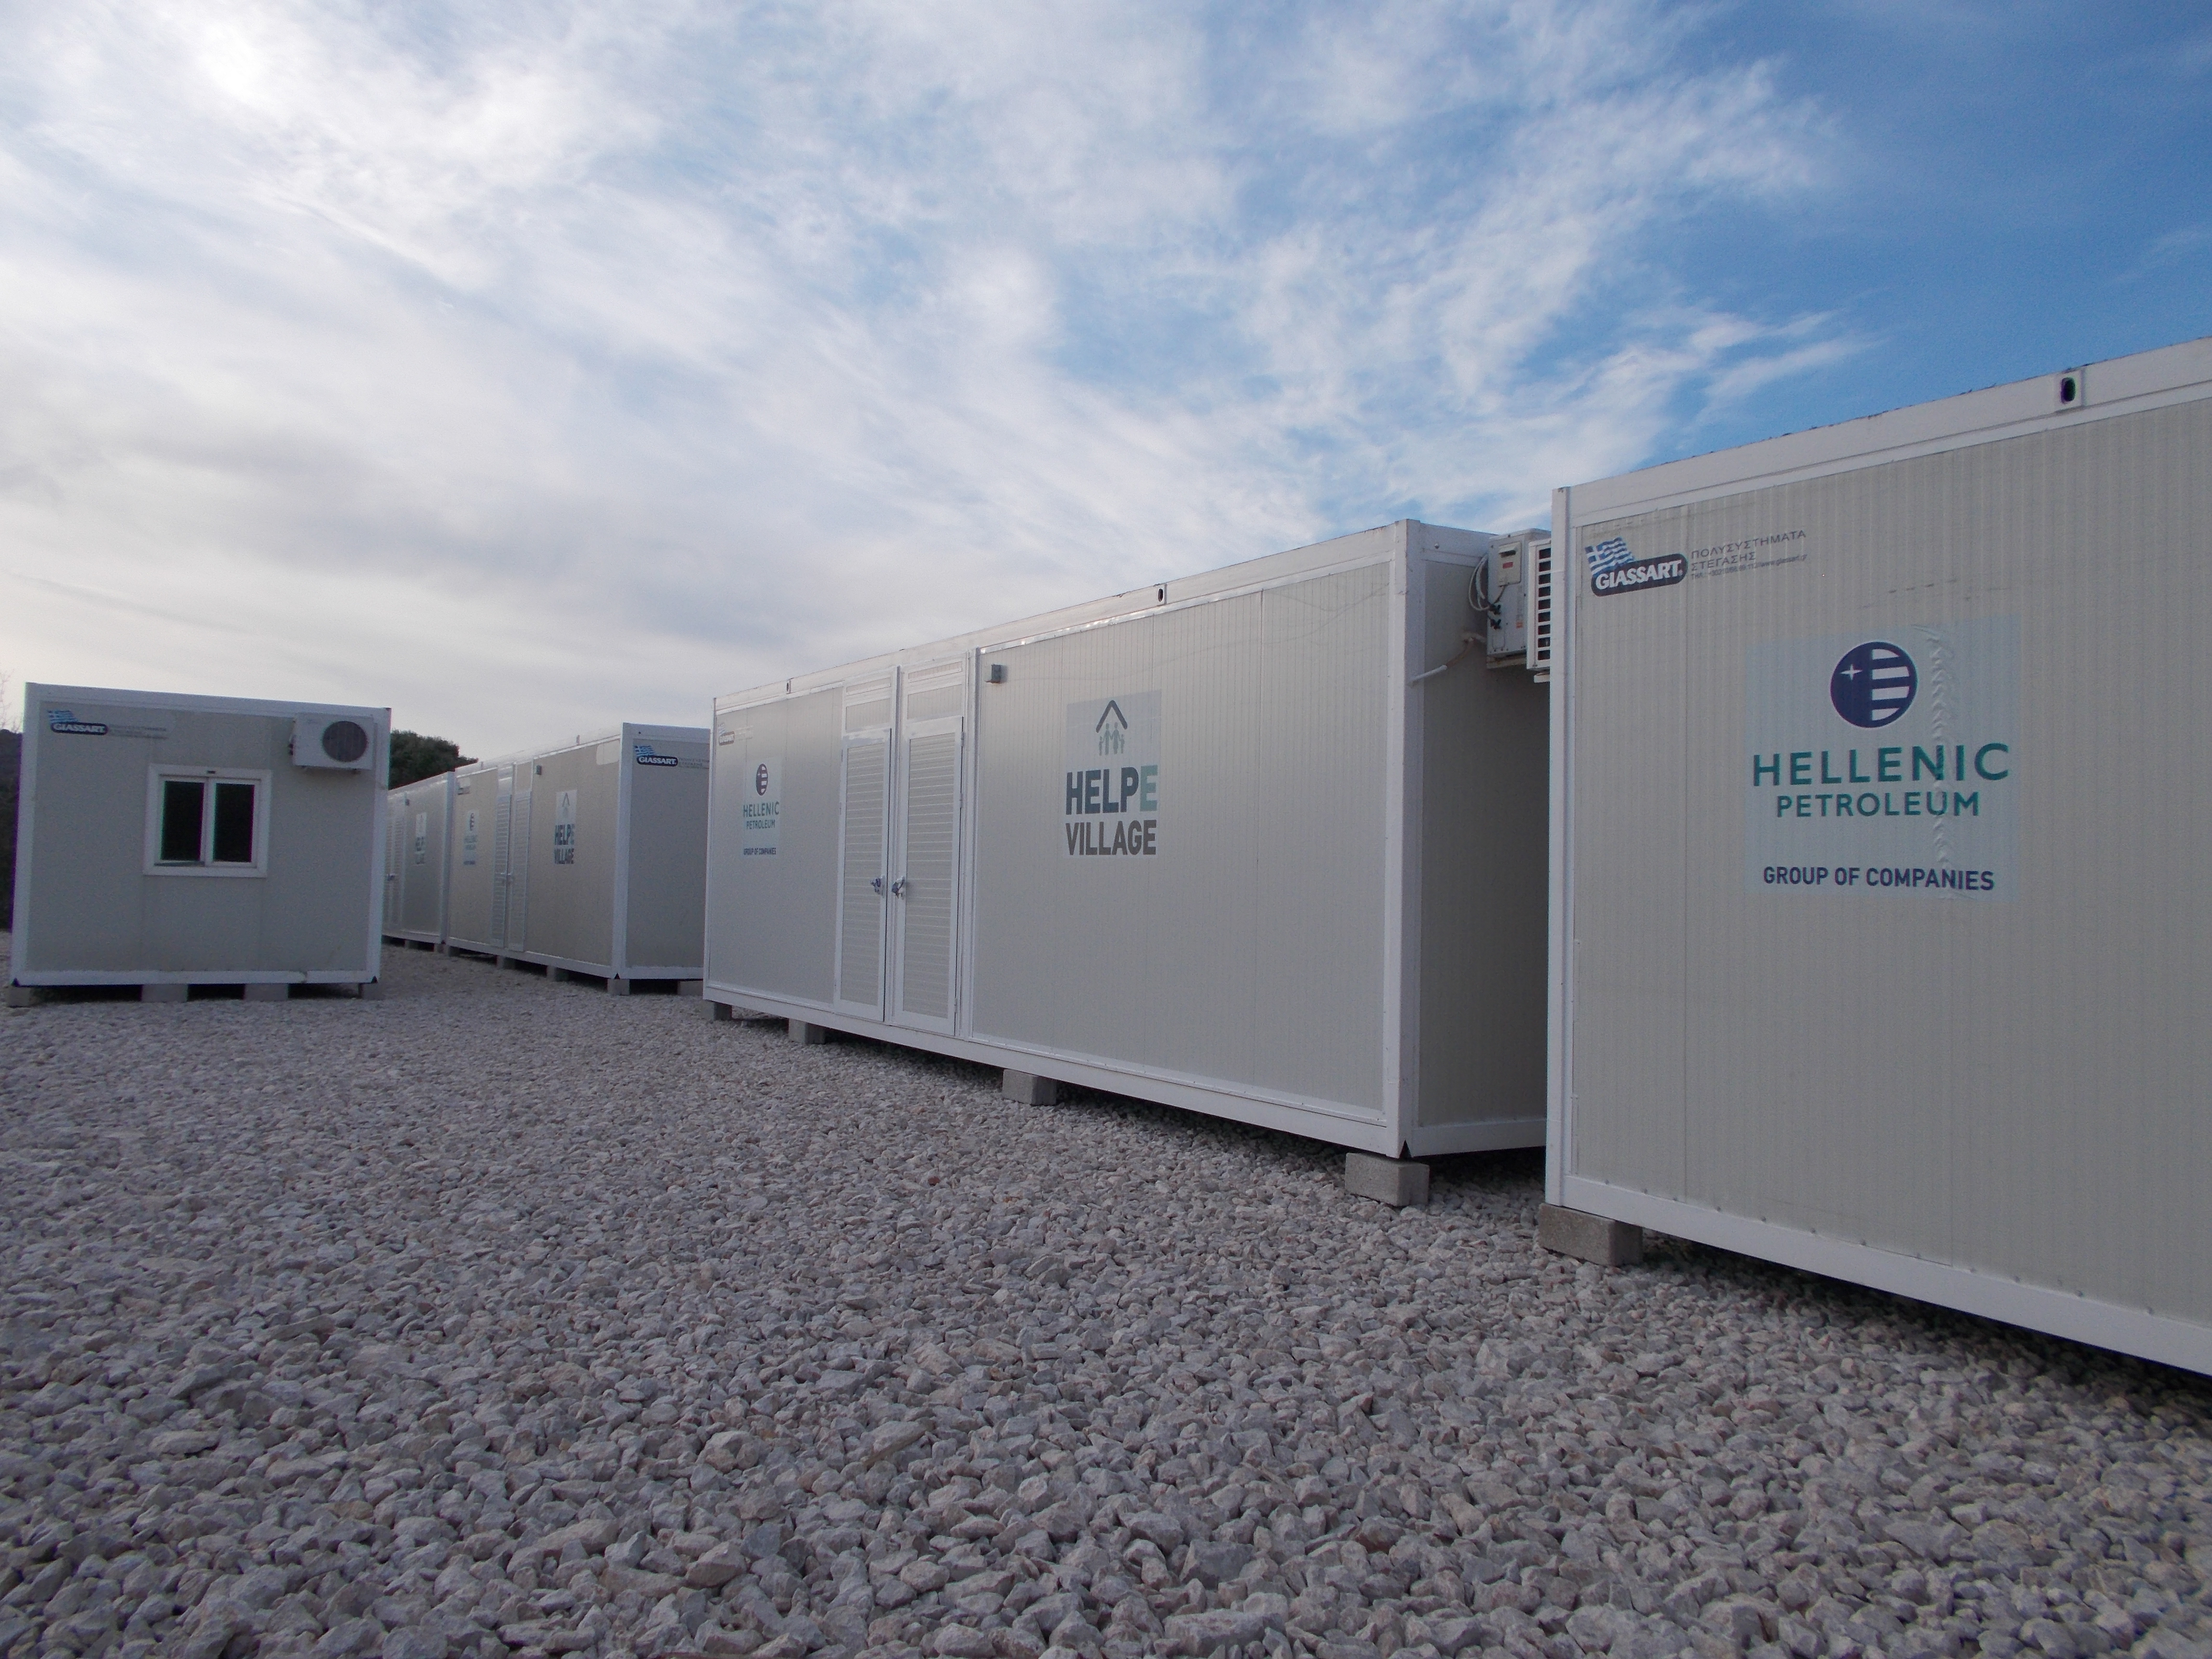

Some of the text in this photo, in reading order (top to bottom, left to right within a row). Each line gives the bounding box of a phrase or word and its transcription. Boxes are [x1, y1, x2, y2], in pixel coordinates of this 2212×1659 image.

[1691, 530, 1806, 559] ΠΟΛΥΣΥΣΤΗΜΑΤΑ
[1691, 552, 1756, 571] ΣΤΕΓΑΣΗΣ
[1753, 742, 2009, 786] HELLENIC
[1065, 765, 1158, 815] HELPE
[743, 801, 780, 817] HELLENIC
[1777, 791, 1980, 817] PETROLEUM
[746, 819, 776, 830] PETROLEUM
[1065, 819, 1157, 855] VILLAGE
[1764, 866, 1995, 891] GROUP OF COMPANIES
